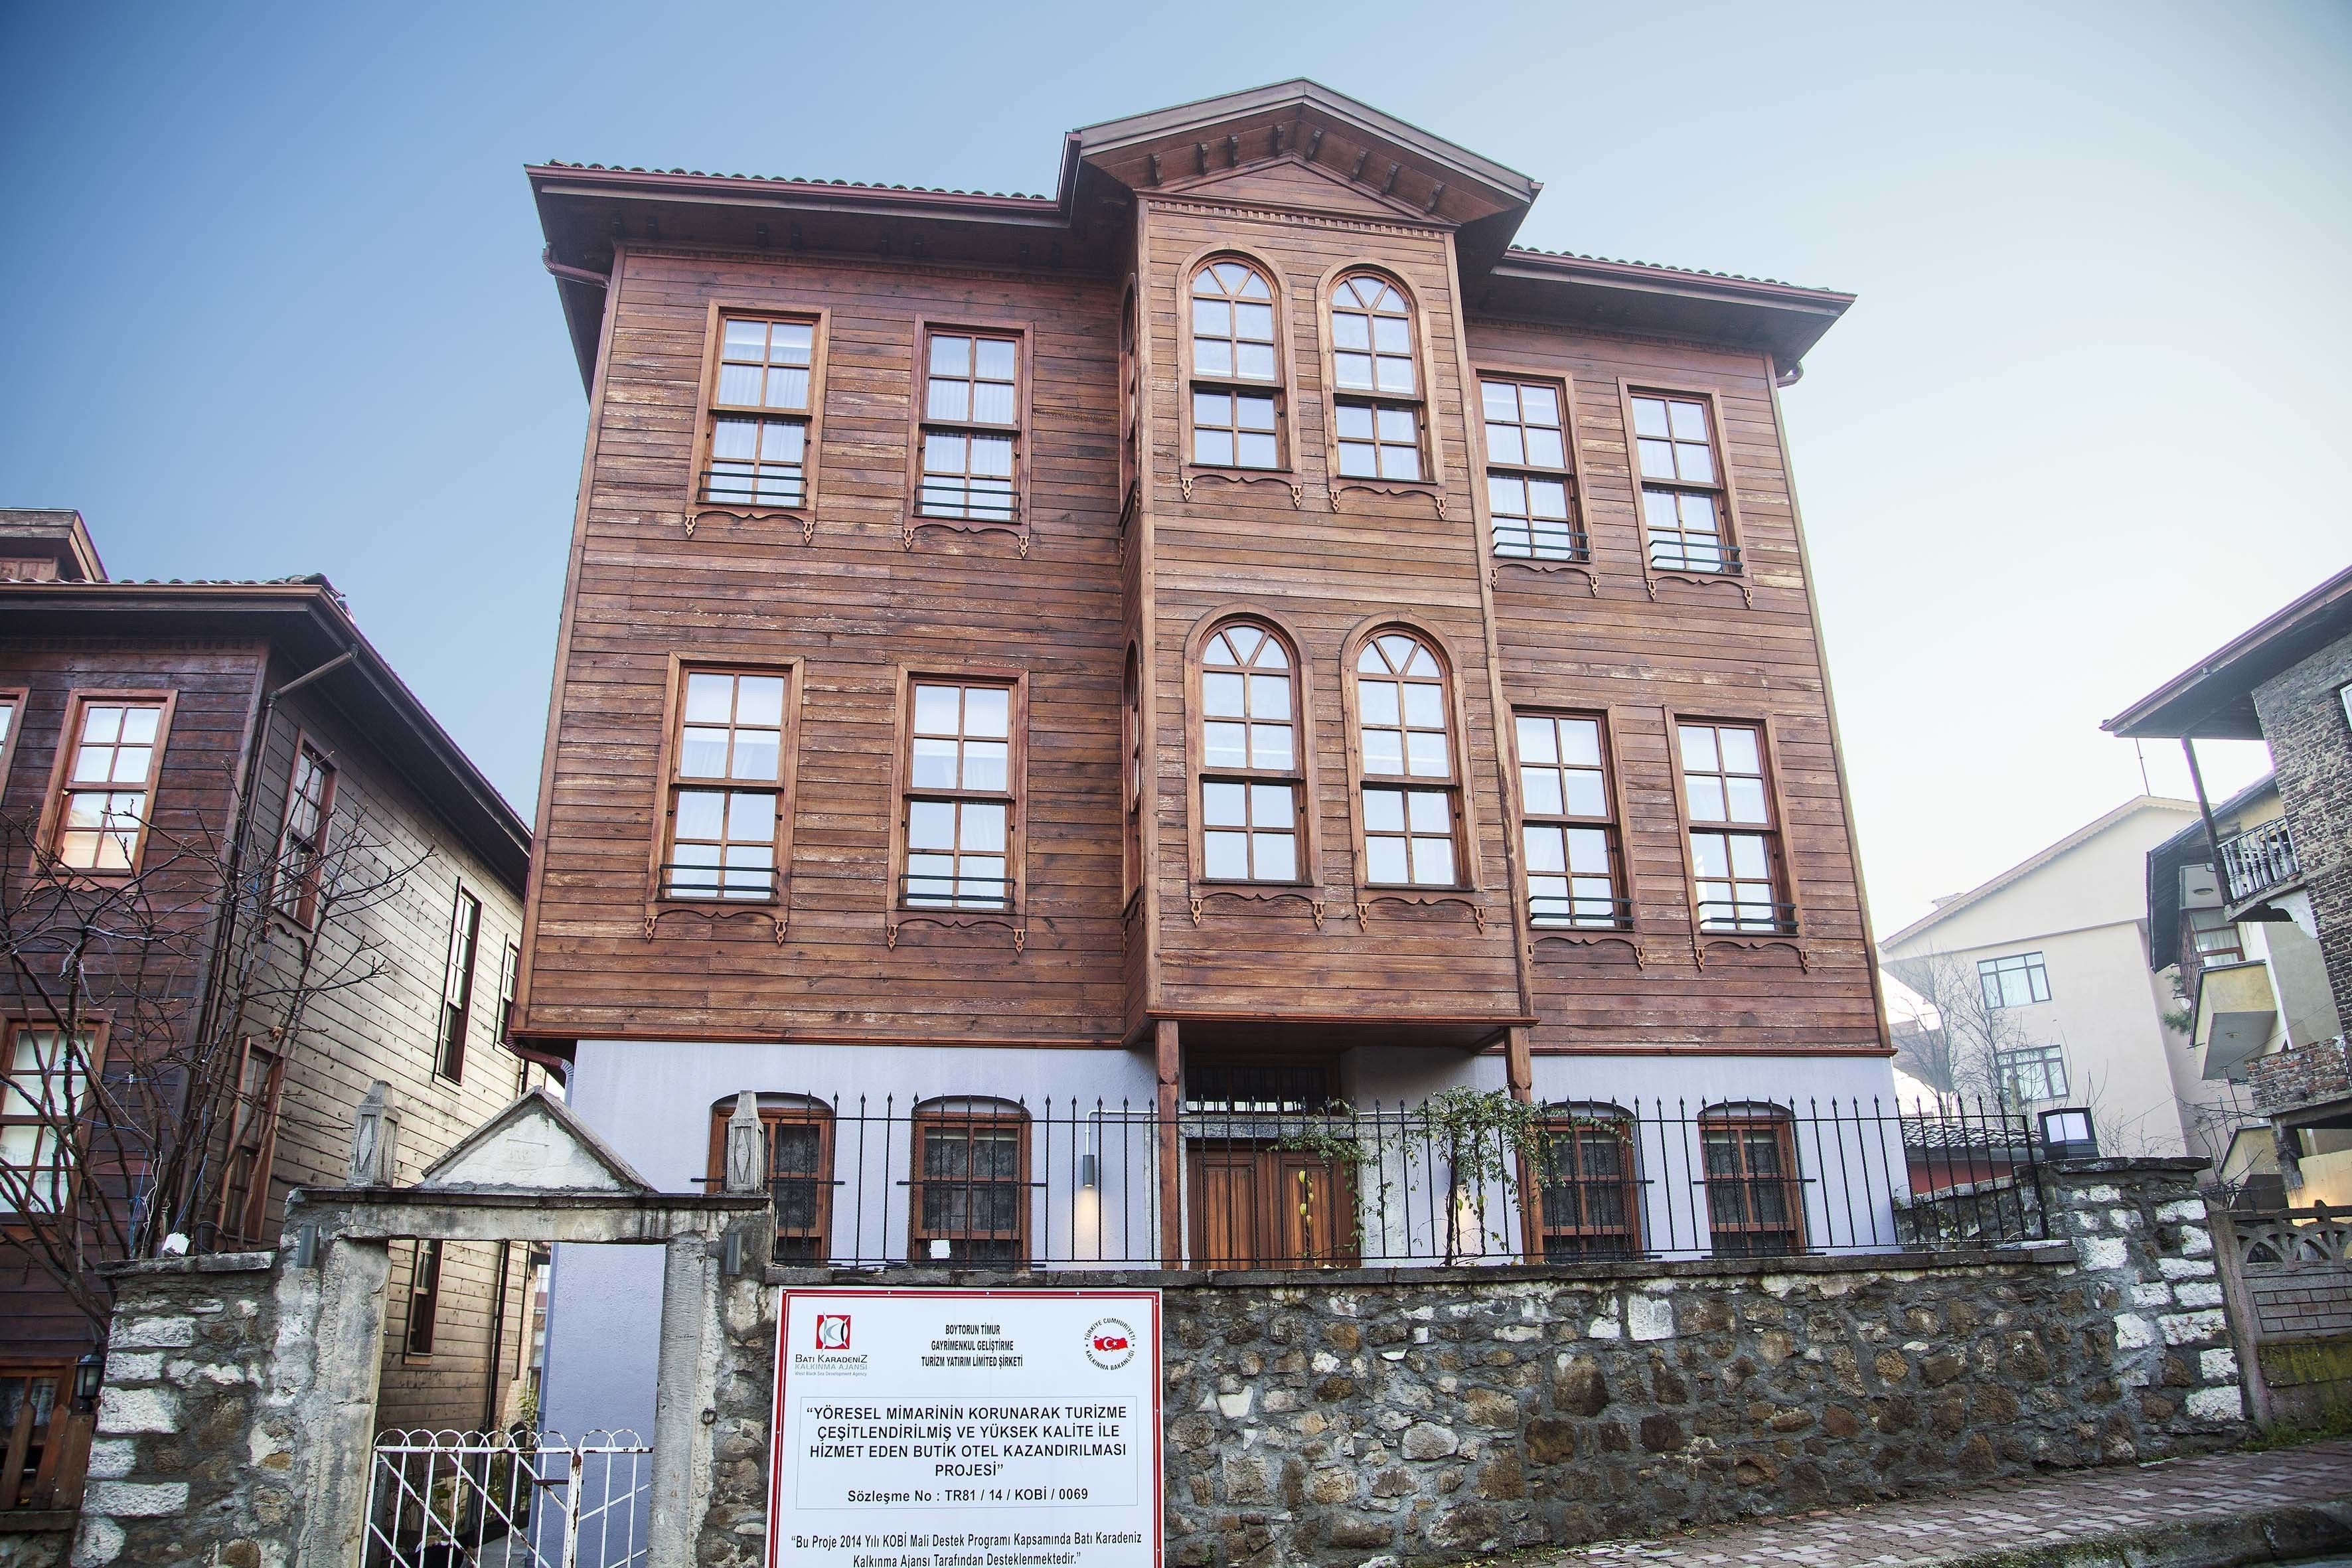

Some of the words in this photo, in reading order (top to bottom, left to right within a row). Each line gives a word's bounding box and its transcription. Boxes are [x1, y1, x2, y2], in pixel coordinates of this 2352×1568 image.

[945, 1324, 979, 1334] BOYTORUN
[981, 1322, 1000, 1334] TİMUR
[931, 1338, 975, 1350] GAYRİMENKUL
[977, 1338, 1014, 1353] GELİŞTİRME
[921, 1354, 945, 1367] TURİZM
[947, 1356, 971, 1367] YATIRIM
[973, 1354, 997, 1367] LİMİTED
[999, 1354, 1023, 1369] ŞİRKETİ
[1085, 1350, 1109, 1370] KALKINMA
[886, 1405, 963, 1420] MİMARİNİN
[969, 1407, 1061, 1420] KORUNARAK
[1065, 1404, 1127, 1419] TURİZME
[817, 1423, 952, 1442] ÇEŞİTLENDİRİLMİŞ
[957, 1427, 975, 1439] VE
[980, 1423, 1038, 1439] YÜKSEK
[1043, 1423, 1094, 1438] KALİTE
[1099, 1423, 1120, 1437] İLE
[810, 1443, 864, 1458] HİZMET
[869, 1446, 908, 1458] EDEN
[913, 1443, 957, 1458] BUTİK
[961, 1445, 999, 1458] OTEL
[1004, 1444, 1126, 1457] KAZANDIRILMASI
[847, 1490, 910, 1505] Sözleşme
[915, 1490, 932, 1502] No
[945, 1490, 975, 1502] TR81
[980, 1490, 985, 1502] /
[989, 1490, 1003, 1501] 14
[1006, 1489, 1011, 1501] /
[1015, 1486, 1047, 1501] KOBİ
[1051, 1488, 1056, 1500] /
[1059, 1488, 1089, 1500] 0069
[812, 1535, 837, 1551] Proje
[840, 1535, 862, 1548] 2014
[865, 1534, 880, 1548] Yılı
[883, 1532, 907, 1548] KOBİ
[910, 1534, 929, 1547] Mali
[933, 1534, 965, 1547] Destek
[968, 1533, 1010, 1549] Programı
[1014, 1532, 1071, 1548] Kapsamında
[1074, 1532, 1093, 1545] Batı
[1096, 1531, 1142, 1544] Karadeniz
[854, 1555, 898, 1568] Kalkınma
[900, 1554, 930, 1568] Ajansı
[933, 1553, 983, 1567] Tarafından
